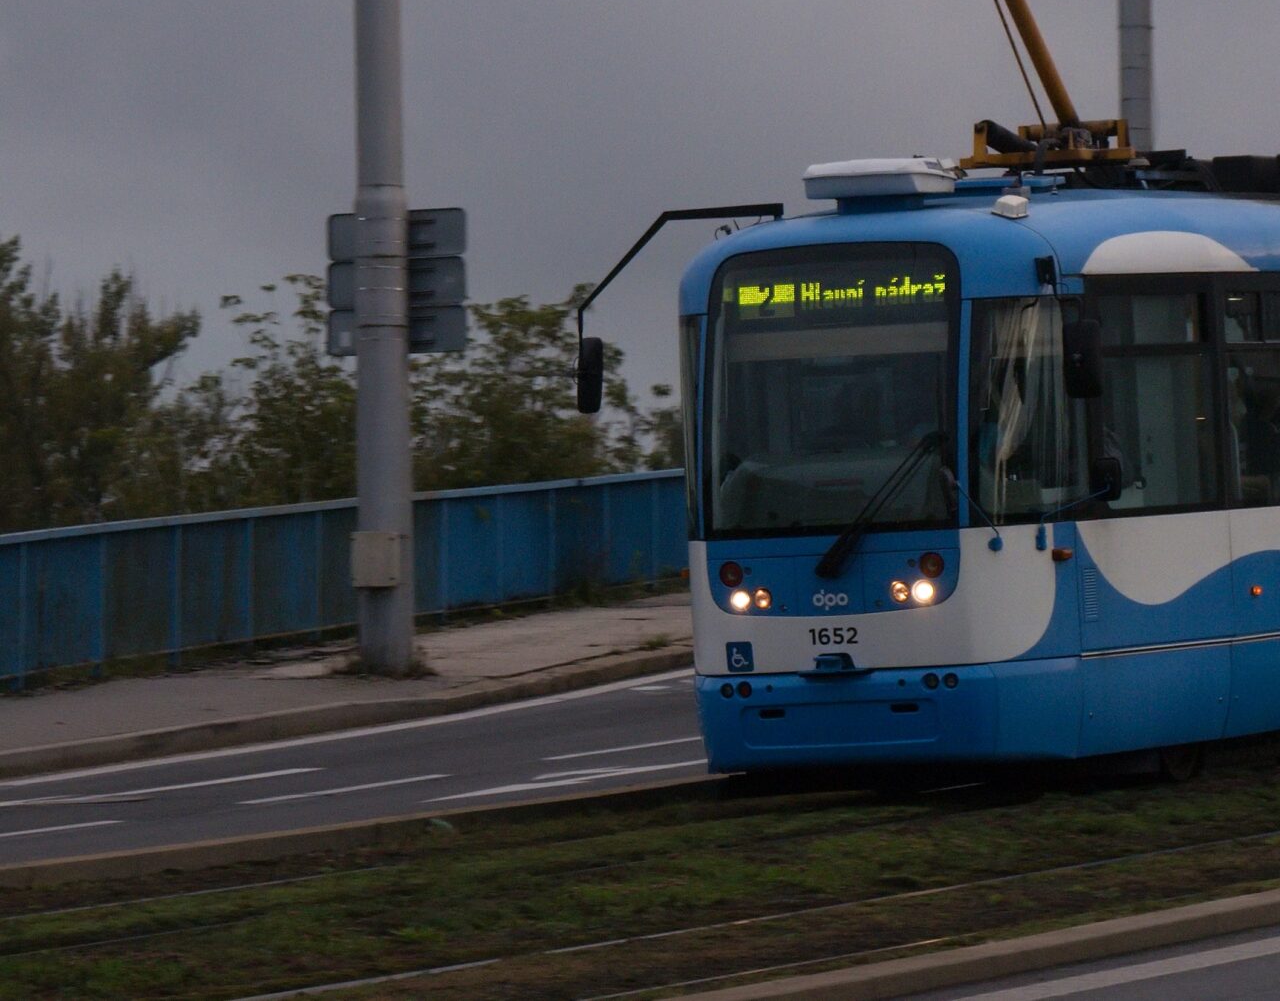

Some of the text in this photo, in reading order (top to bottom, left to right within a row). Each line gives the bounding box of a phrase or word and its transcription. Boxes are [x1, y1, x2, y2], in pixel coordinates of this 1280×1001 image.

[800, 279, 865, 307] Hlavní
[812, 589, 848, 611] dpo
[808, 627, 859, 646] 1652
